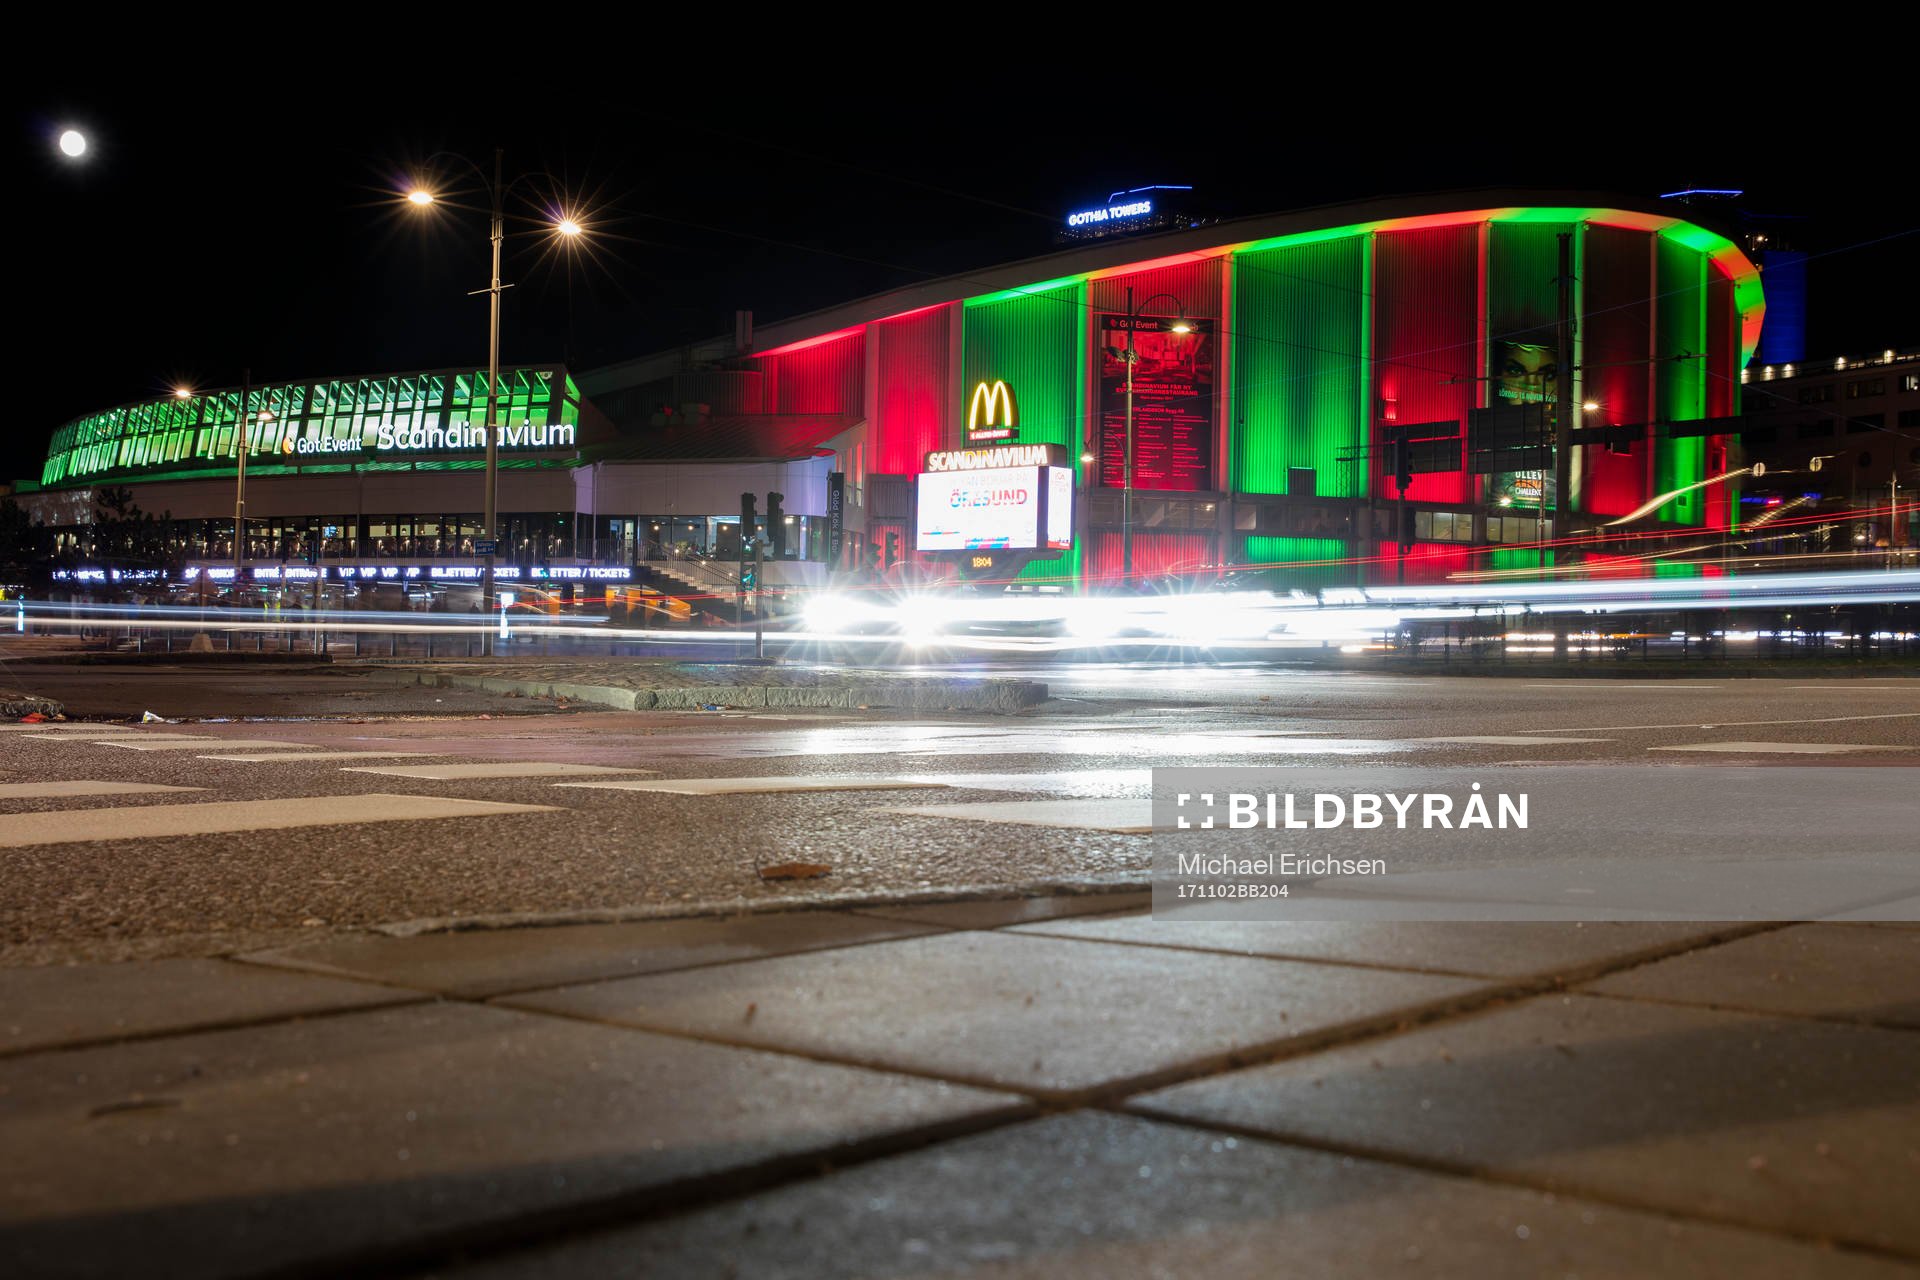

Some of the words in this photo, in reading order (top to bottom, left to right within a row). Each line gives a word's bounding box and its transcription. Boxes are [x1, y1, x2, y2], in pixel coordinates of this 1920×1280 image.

[1069, 209, 1108, 225] GOTHIA
[1109, 201, 1151, 219] TOWERS
[1136, 321, 1158, 329] Event
[297, 437, 323, 454] Got
[324, 435, 362, 453] Event
[929, 445, 1048, 472] SCANDINAVIUM
[950, 488, 1028, 508] ÖRESUND
[339, 567, 355, 577] VIP
[360, 567, 376, 577] VIP
[381, 567, 398, 577] VIP
[588, 567, 630, 578] TICKETS
